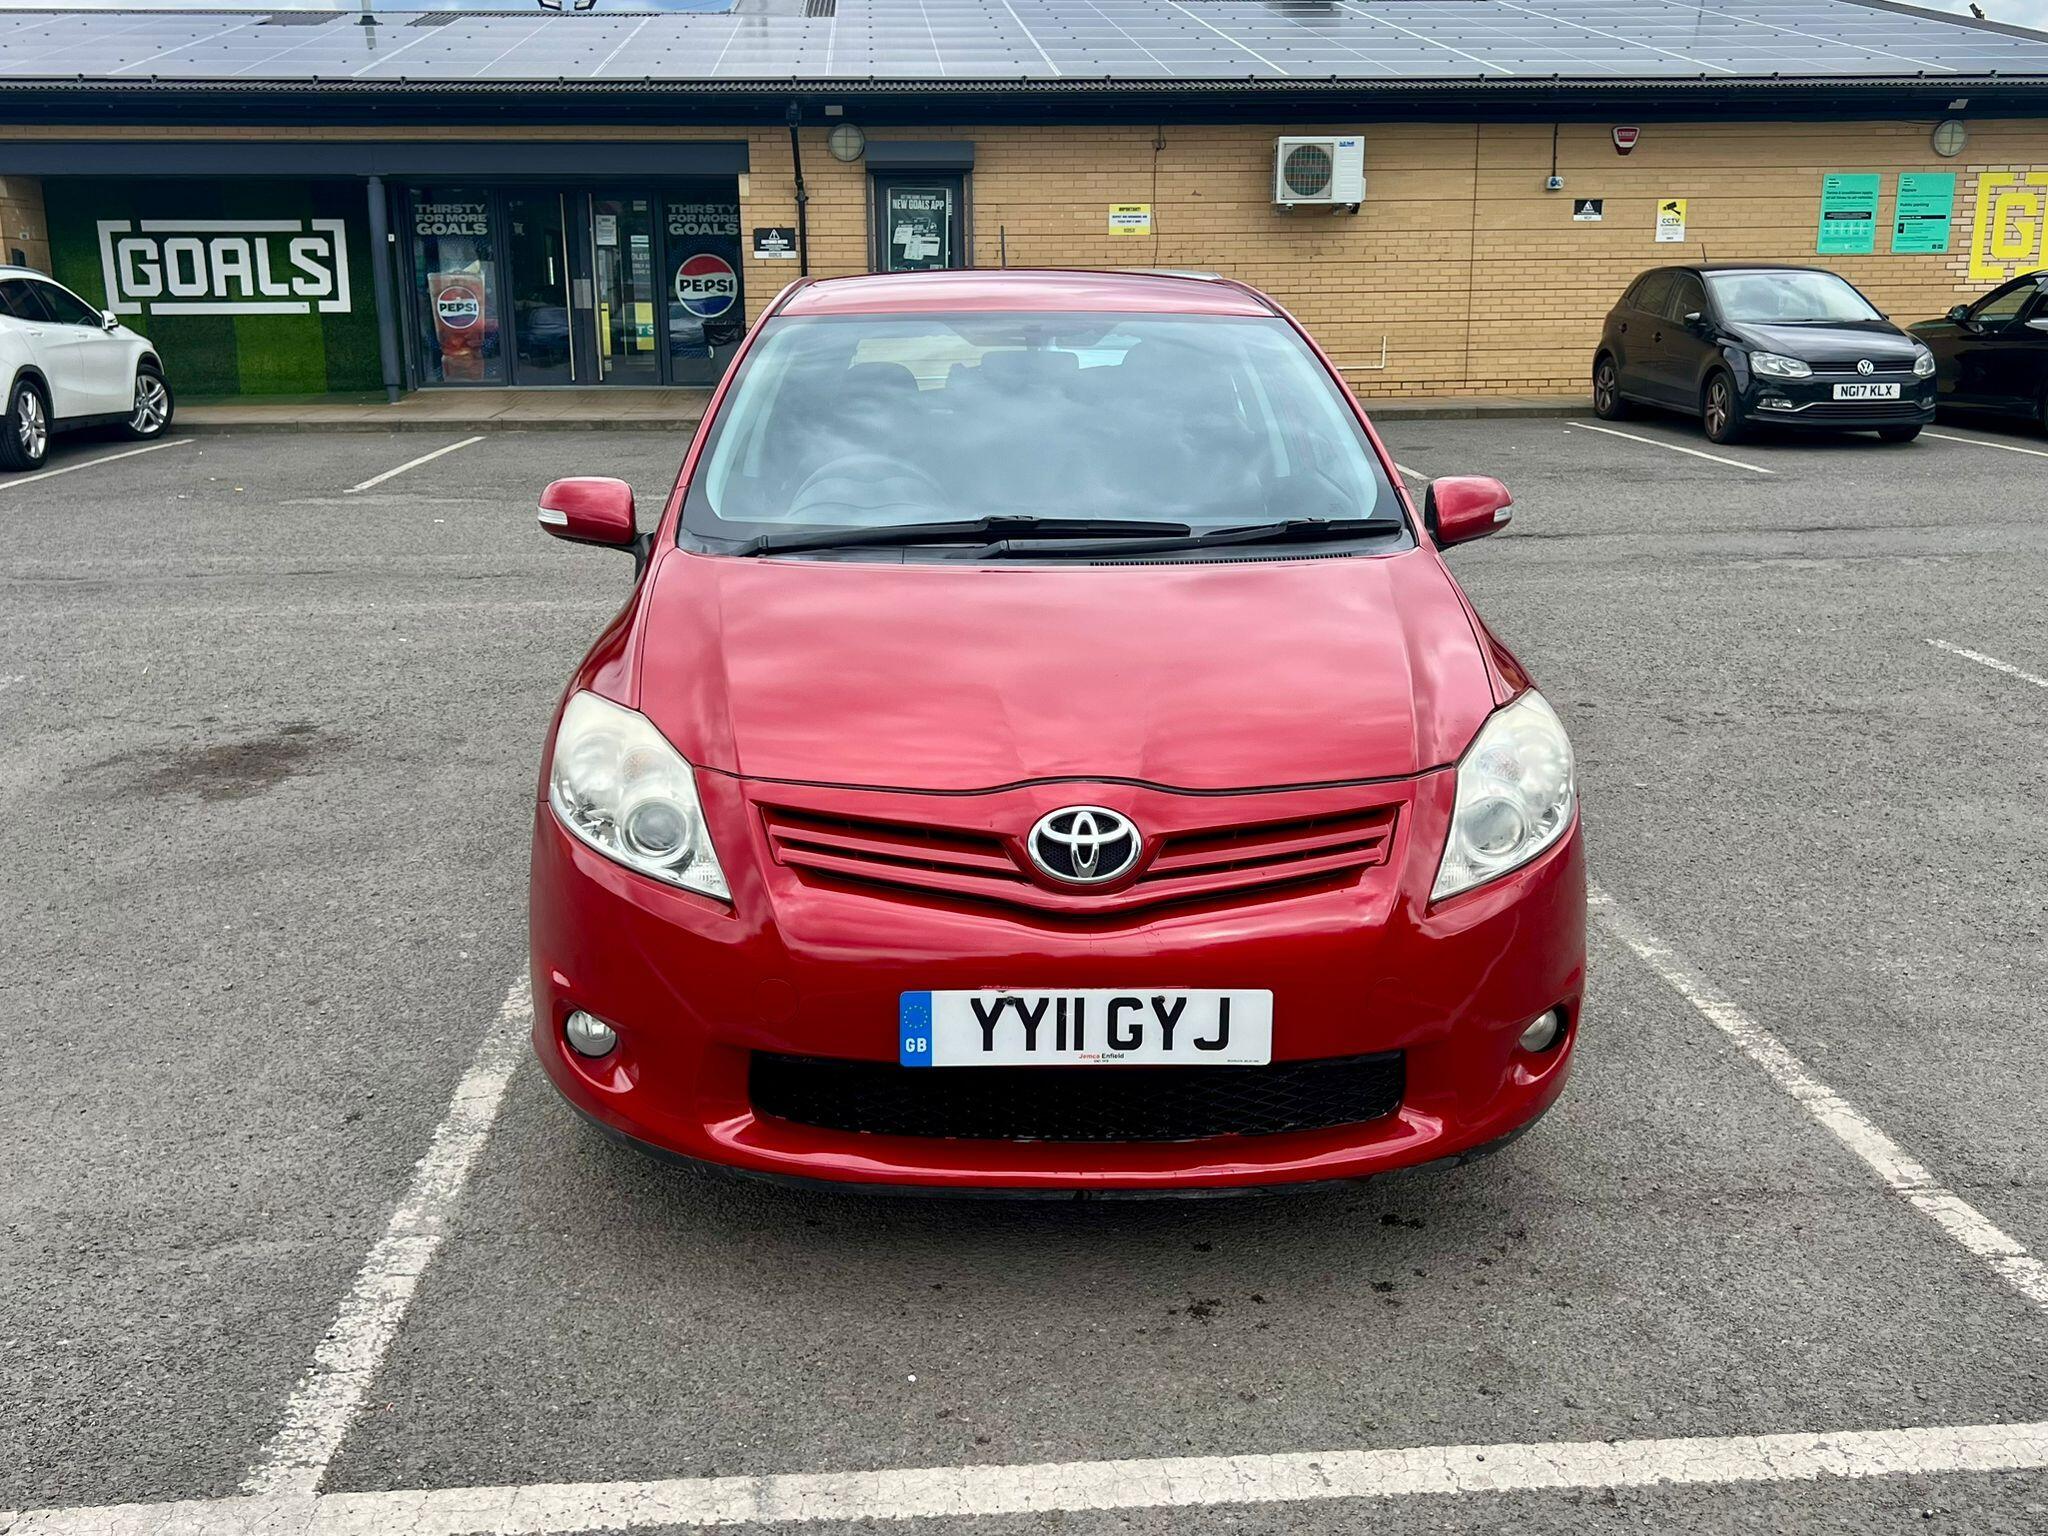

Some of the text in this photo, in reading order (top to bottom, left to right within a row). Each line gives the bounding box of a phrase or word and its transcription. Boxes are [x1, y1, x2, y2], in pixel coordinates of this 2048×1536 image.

[414, 203, 486, 214] THIRSTY
[667, 204, 738, 214] THIRSTY
[892, 199, 945, 210] NEW GOALS APP
[415, 213, 488, 223] FOR MORE
[668, 214, 739, 223] FOR MORE
[416, 223, 488, 236] GOALS
[669, 223, 739, 236] GOALS
[117, 237, 333, 297] GOALS
[680, 279, 734, 292] PEPSI
[439, 302, 477, 313] PEPSI
[1840, 385, 1893, 397] NG17 KLX
[970, 996, 1231, 1052] YY11 GYJ
[904, 1037, 928, 1053] GB
